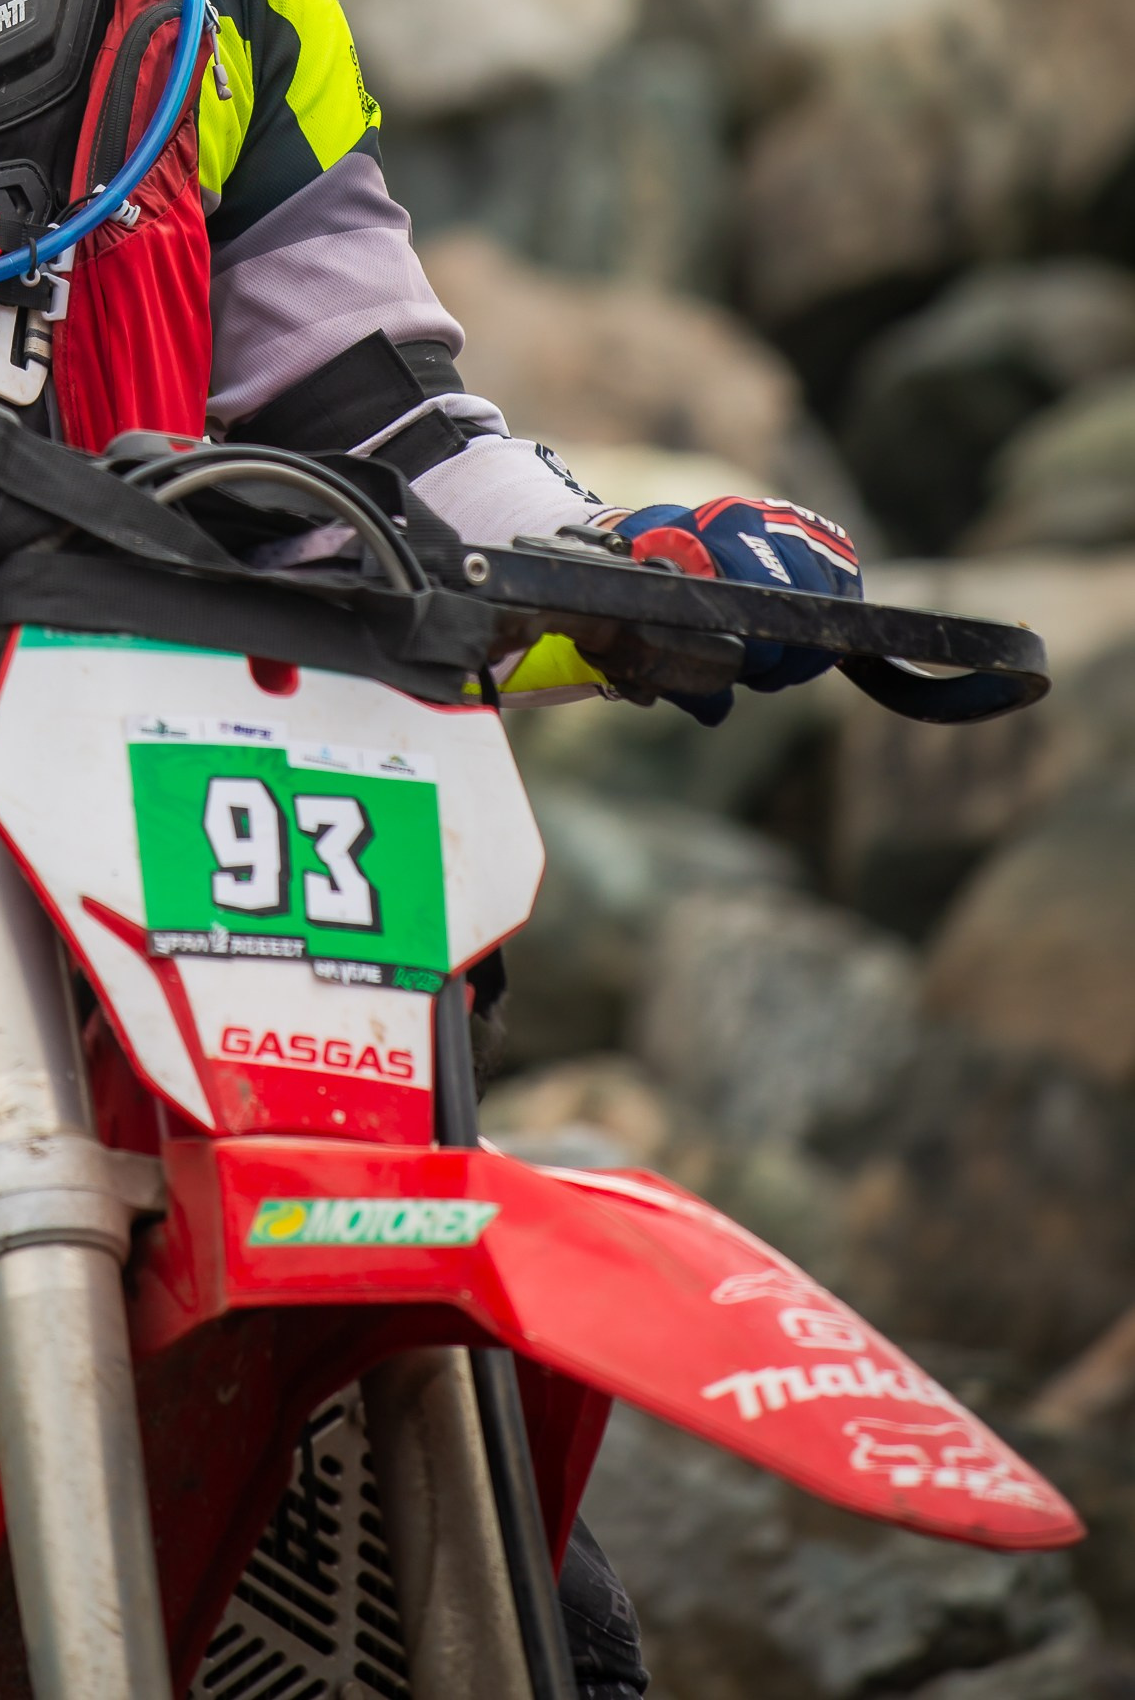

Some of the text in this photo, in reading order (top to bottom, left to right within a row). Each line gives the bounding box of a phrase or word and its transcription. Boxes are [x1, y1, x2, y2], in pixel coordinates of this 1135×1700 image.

[202, 775, 382, 937] 93
[220, 1026, 415, 1081] GASGAS
[303, 1198, 498, 1244] MOTOREX
